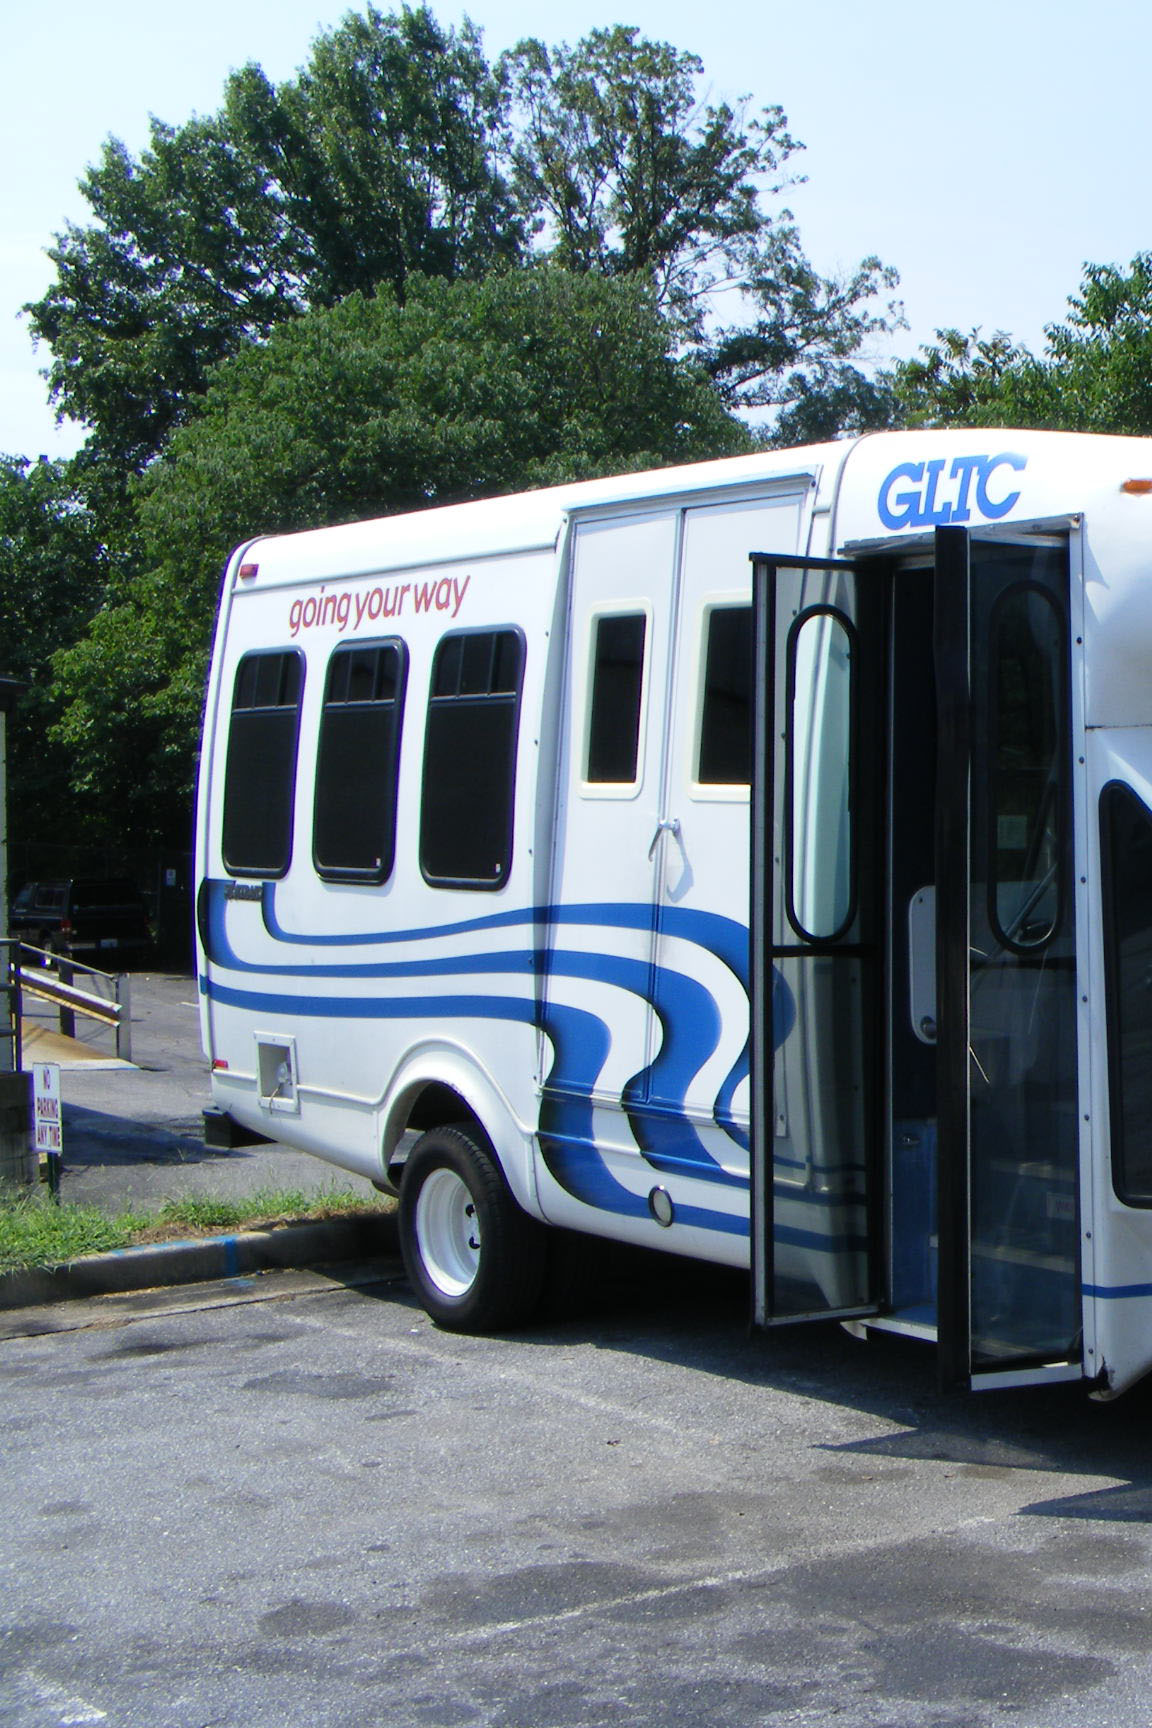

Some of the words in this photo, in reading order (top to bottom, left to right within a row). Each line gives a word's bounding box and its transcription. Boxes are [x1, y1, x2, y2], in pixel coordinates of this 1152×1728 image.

[877, 451, 1028, 531] GLTC
[289, 585, 351, 638] going
[353, 583, 411, 631] your
[414, 575, 471, 619] way
[37, 1097, 58, 1118] PARKING
